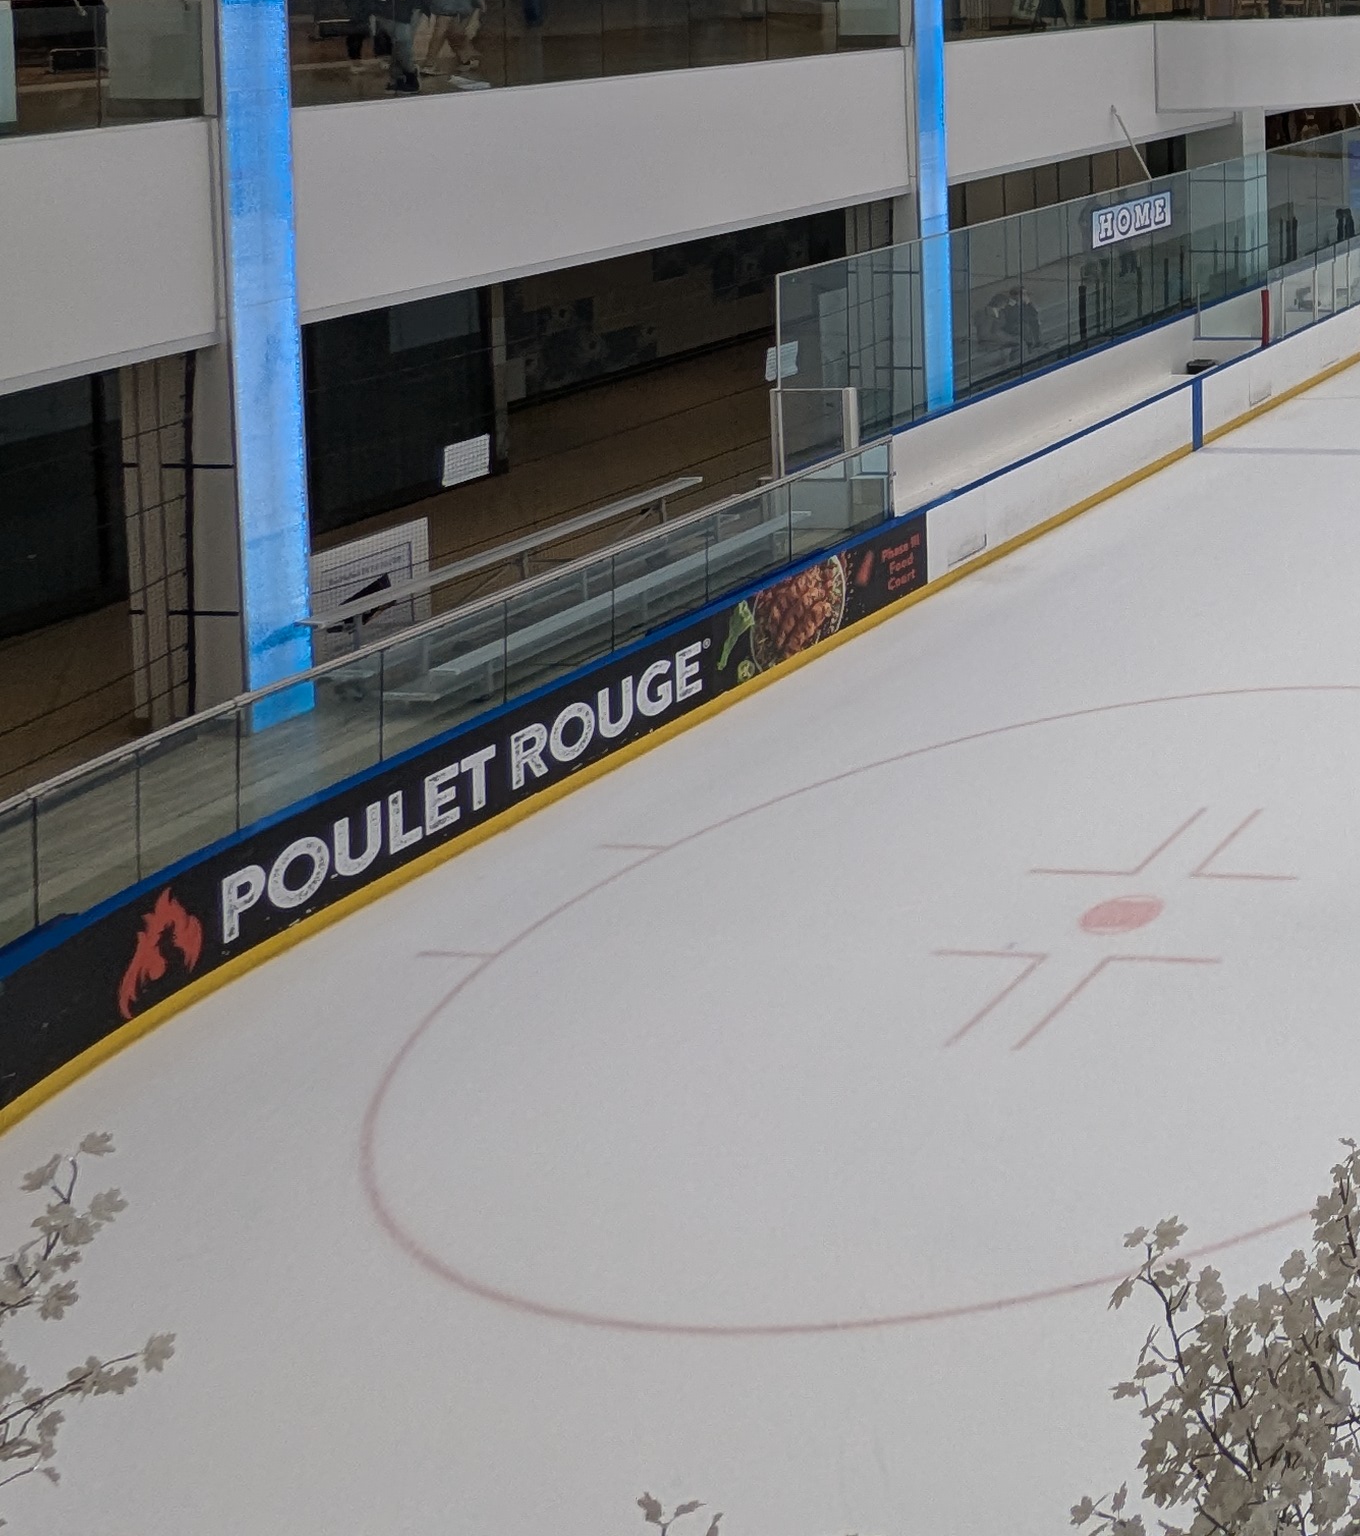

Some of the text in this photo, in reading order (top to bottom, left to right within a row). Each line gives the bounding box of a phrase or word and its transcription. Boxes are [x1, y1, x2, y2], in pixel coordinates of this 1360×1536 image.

[1098, 197, 1168, 241] HOME
[881, 543, 909, 563] Phase
[889, 551, 914, 575] Food
[887, 568, 917, 591] Court
[221, 640, 703, 945] POULET ROUGE
